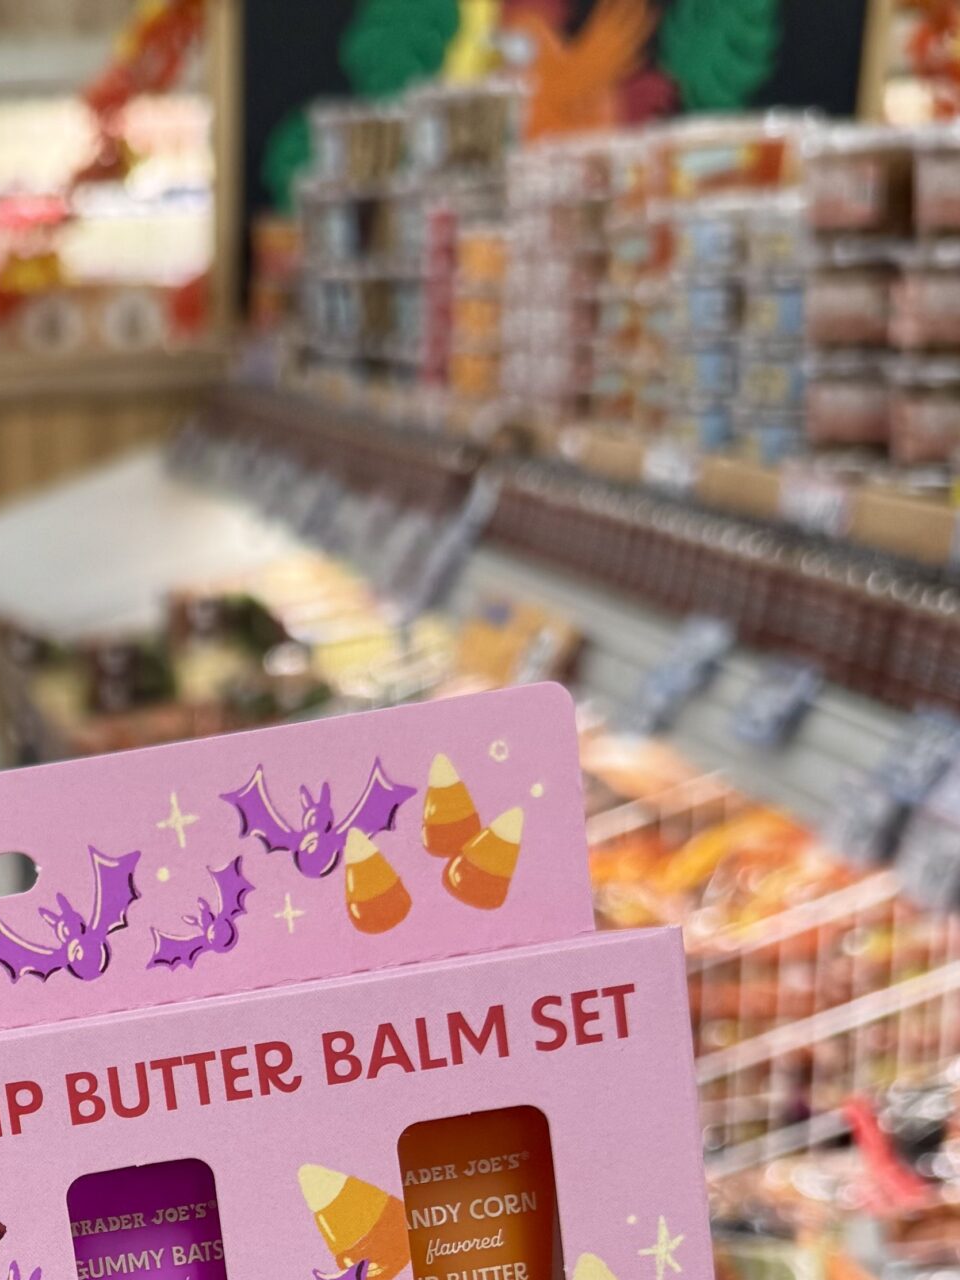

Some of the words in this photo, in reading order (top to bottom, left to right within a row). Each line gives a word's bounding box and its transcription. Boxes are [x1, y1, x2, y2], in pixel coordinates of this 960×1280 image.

[66, 1040, 302, 1126] BUTTER
[322, 1004, 511, 1086] BALM
[531, 983, 638, 1052] SET
[404, 1164, 459, 1186] ADER
[70, 1212, 148, 1238] TRADER
[406, 1202, 462, 1230] NDY
[469, 1191, 537, 1220] CORN
[75, 1248, 165, 1280] GUMMY
[171, 1239, 224, 1267] BATS
[425, 1228, 504, 1265] flavored
